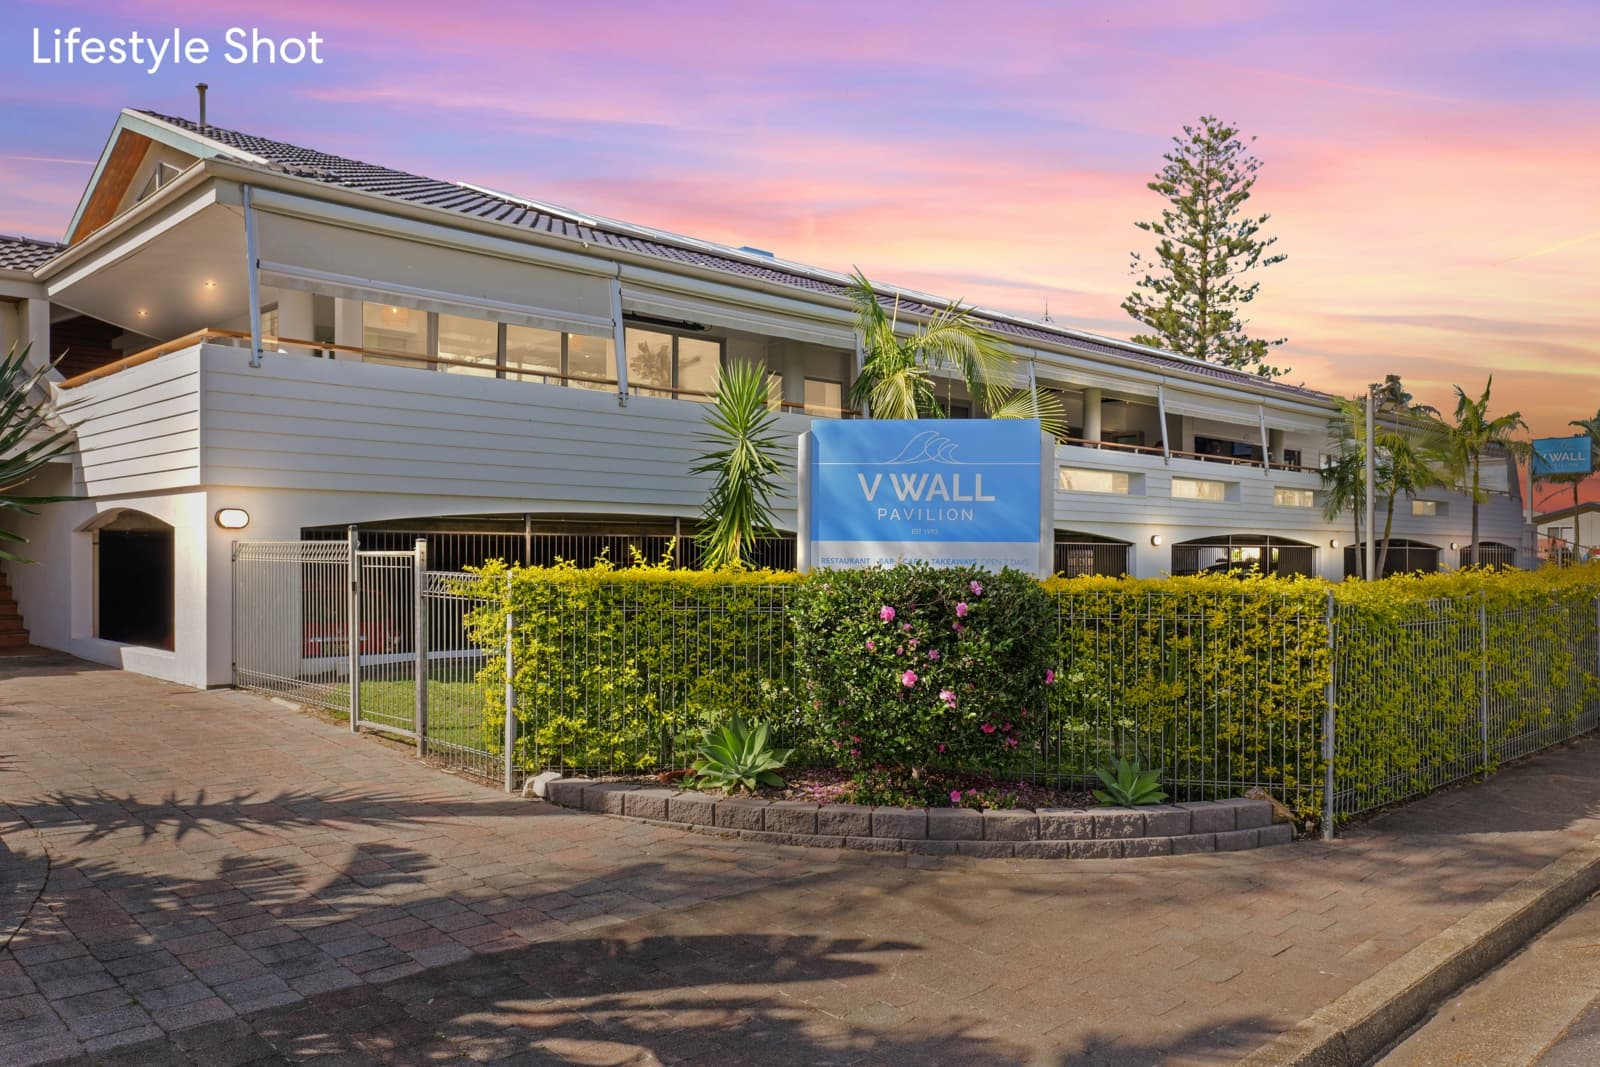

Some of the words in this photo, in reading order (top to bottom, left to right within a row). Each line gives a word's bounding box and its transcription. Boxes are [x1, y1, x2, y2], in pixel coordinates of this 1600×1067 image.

[1549, 451, 1584, 462] WALL
[857, 473, 883, 502] V
[889, 473, 996, 502] WALL
[877, 507, 974, 521] PAVILION
